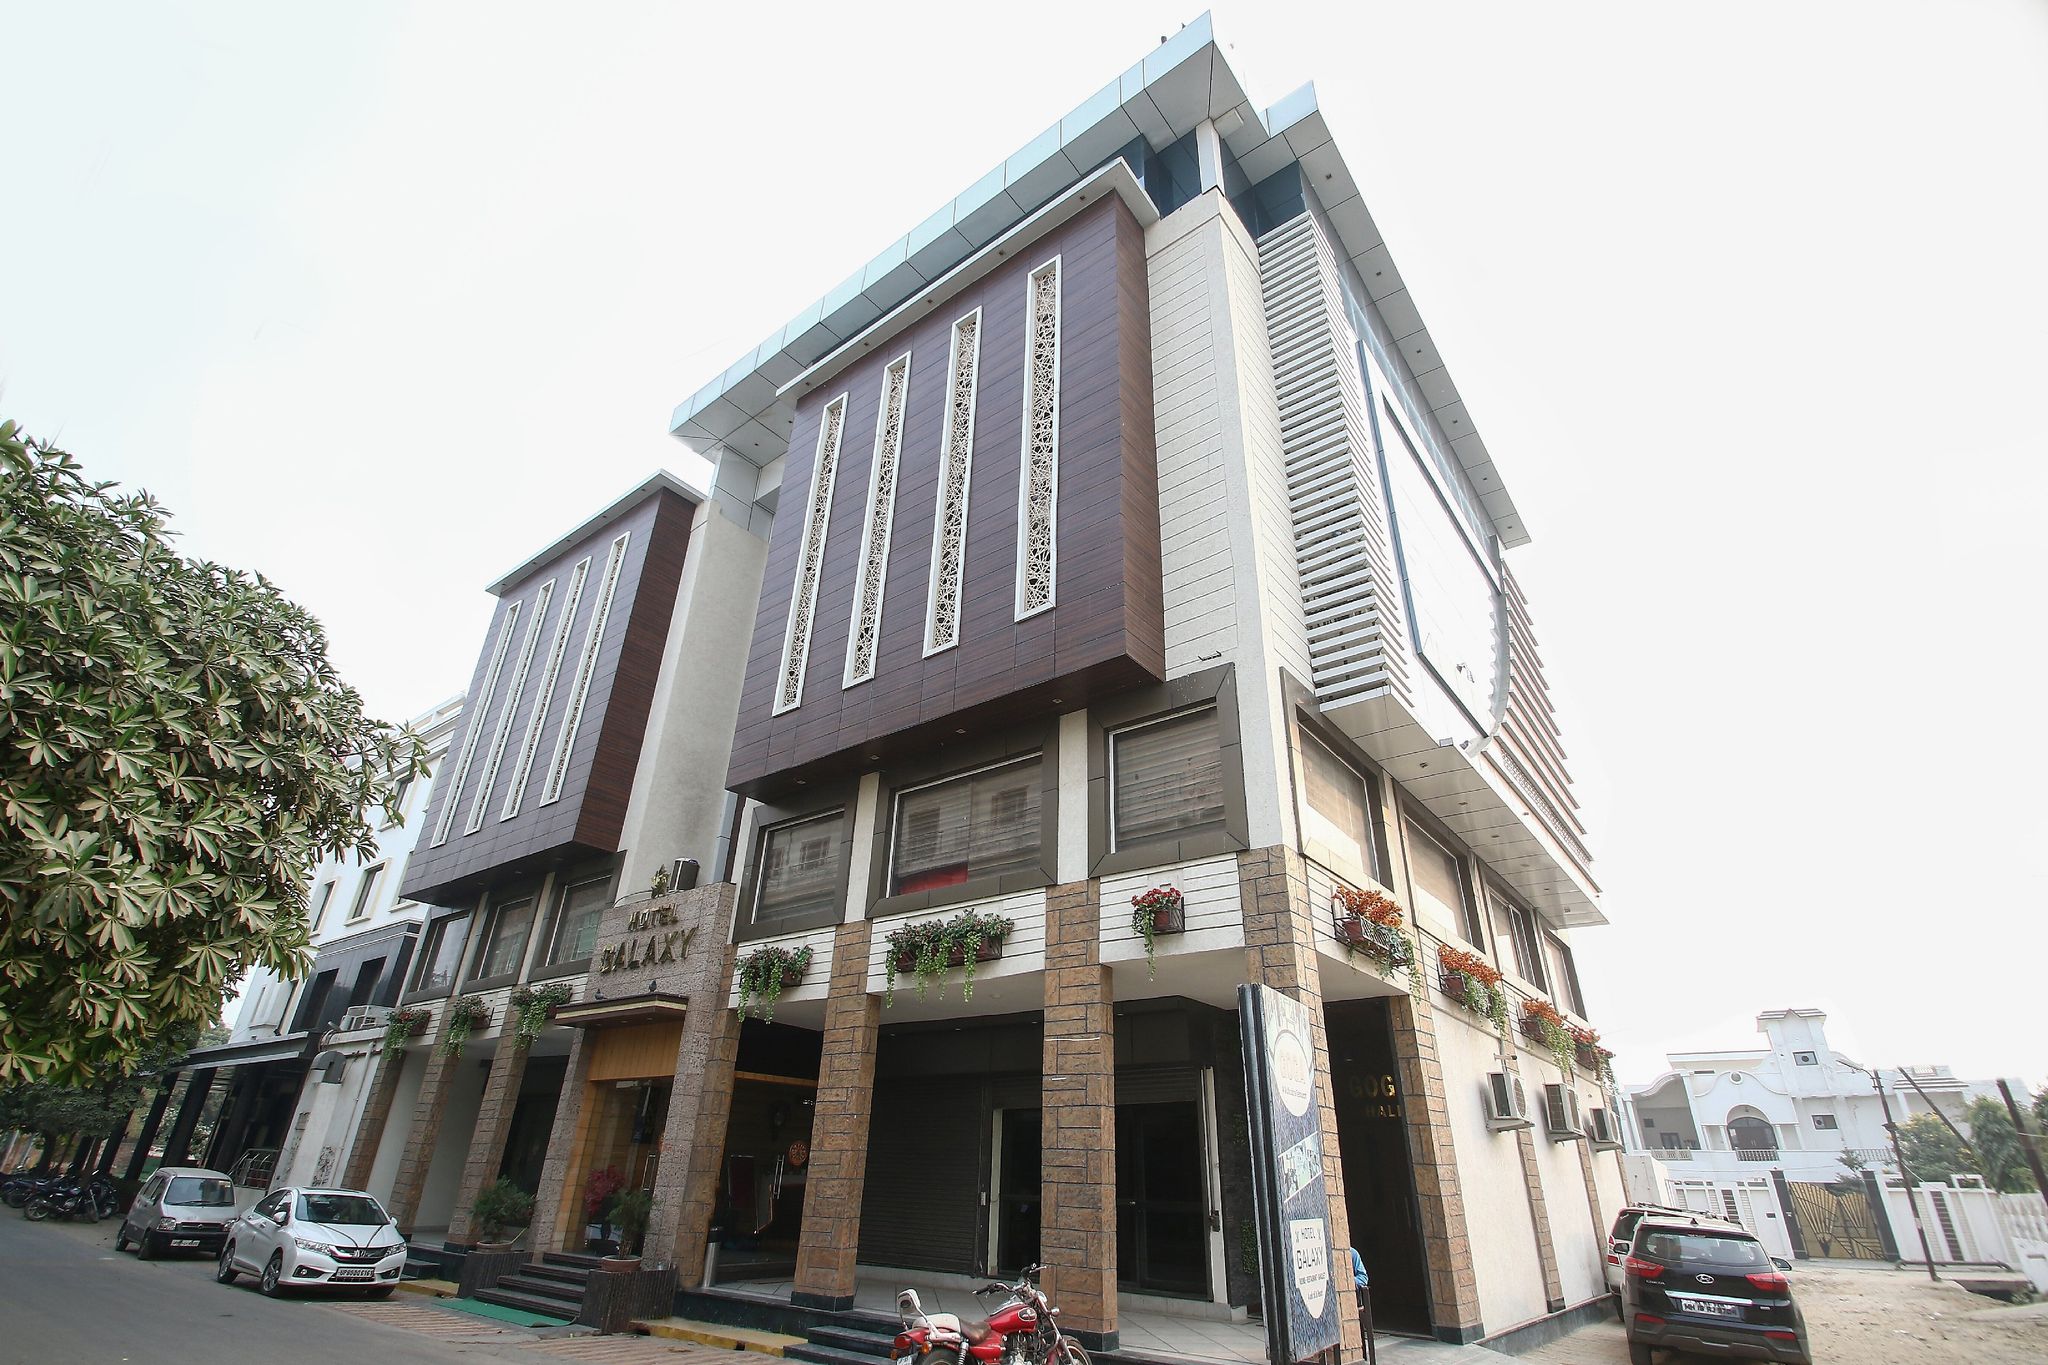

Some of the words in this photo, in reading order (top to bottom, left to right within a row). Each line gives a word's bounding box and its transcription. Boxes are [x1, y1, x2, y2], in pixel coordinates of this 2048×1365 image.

[627, 903, 679, 932] HOTEL
[599, 924, 699, 975] GALAXY
[1300, 1227, 1316, 1240] HOTEL
[1296, 1246, 1324, 1270] GALAXY
